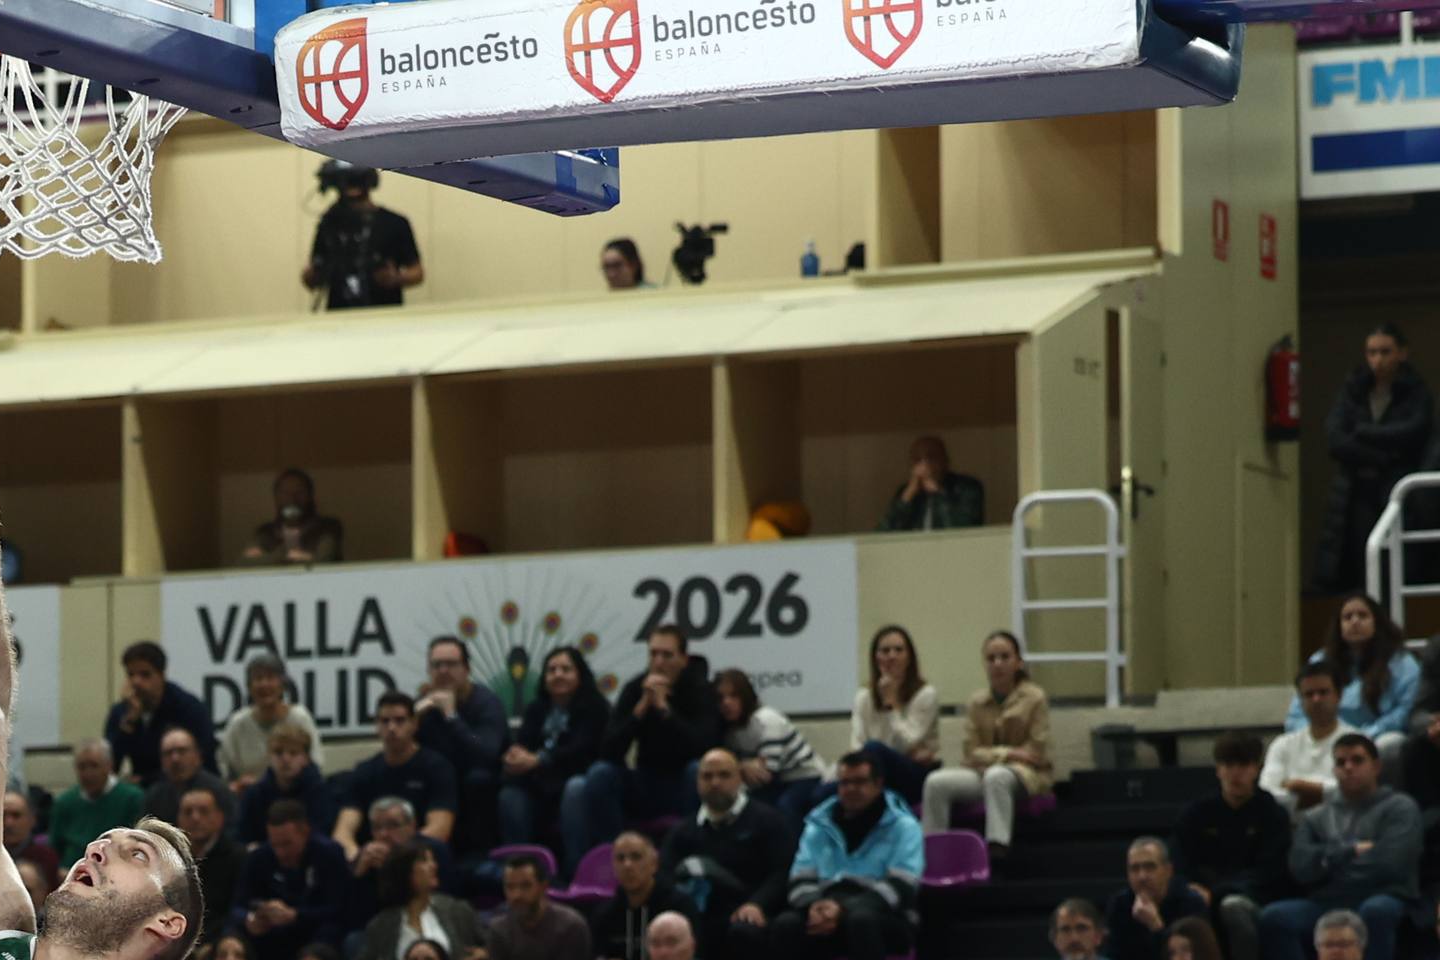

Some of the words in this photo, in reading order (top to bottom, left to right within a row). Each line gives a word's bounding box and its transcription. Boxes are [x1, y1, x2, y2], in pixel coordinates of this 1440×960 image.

[936, 8, 1008, 27] ESPAÑA
[654, 42, 722, 61] ESPAÑA
[381, 75, 448, 93] ESPAÑA
[632, 570, 809, 642] 2026
[197, 598, 395, 663] VALLA
[203, 667, 400, 732] DLID
